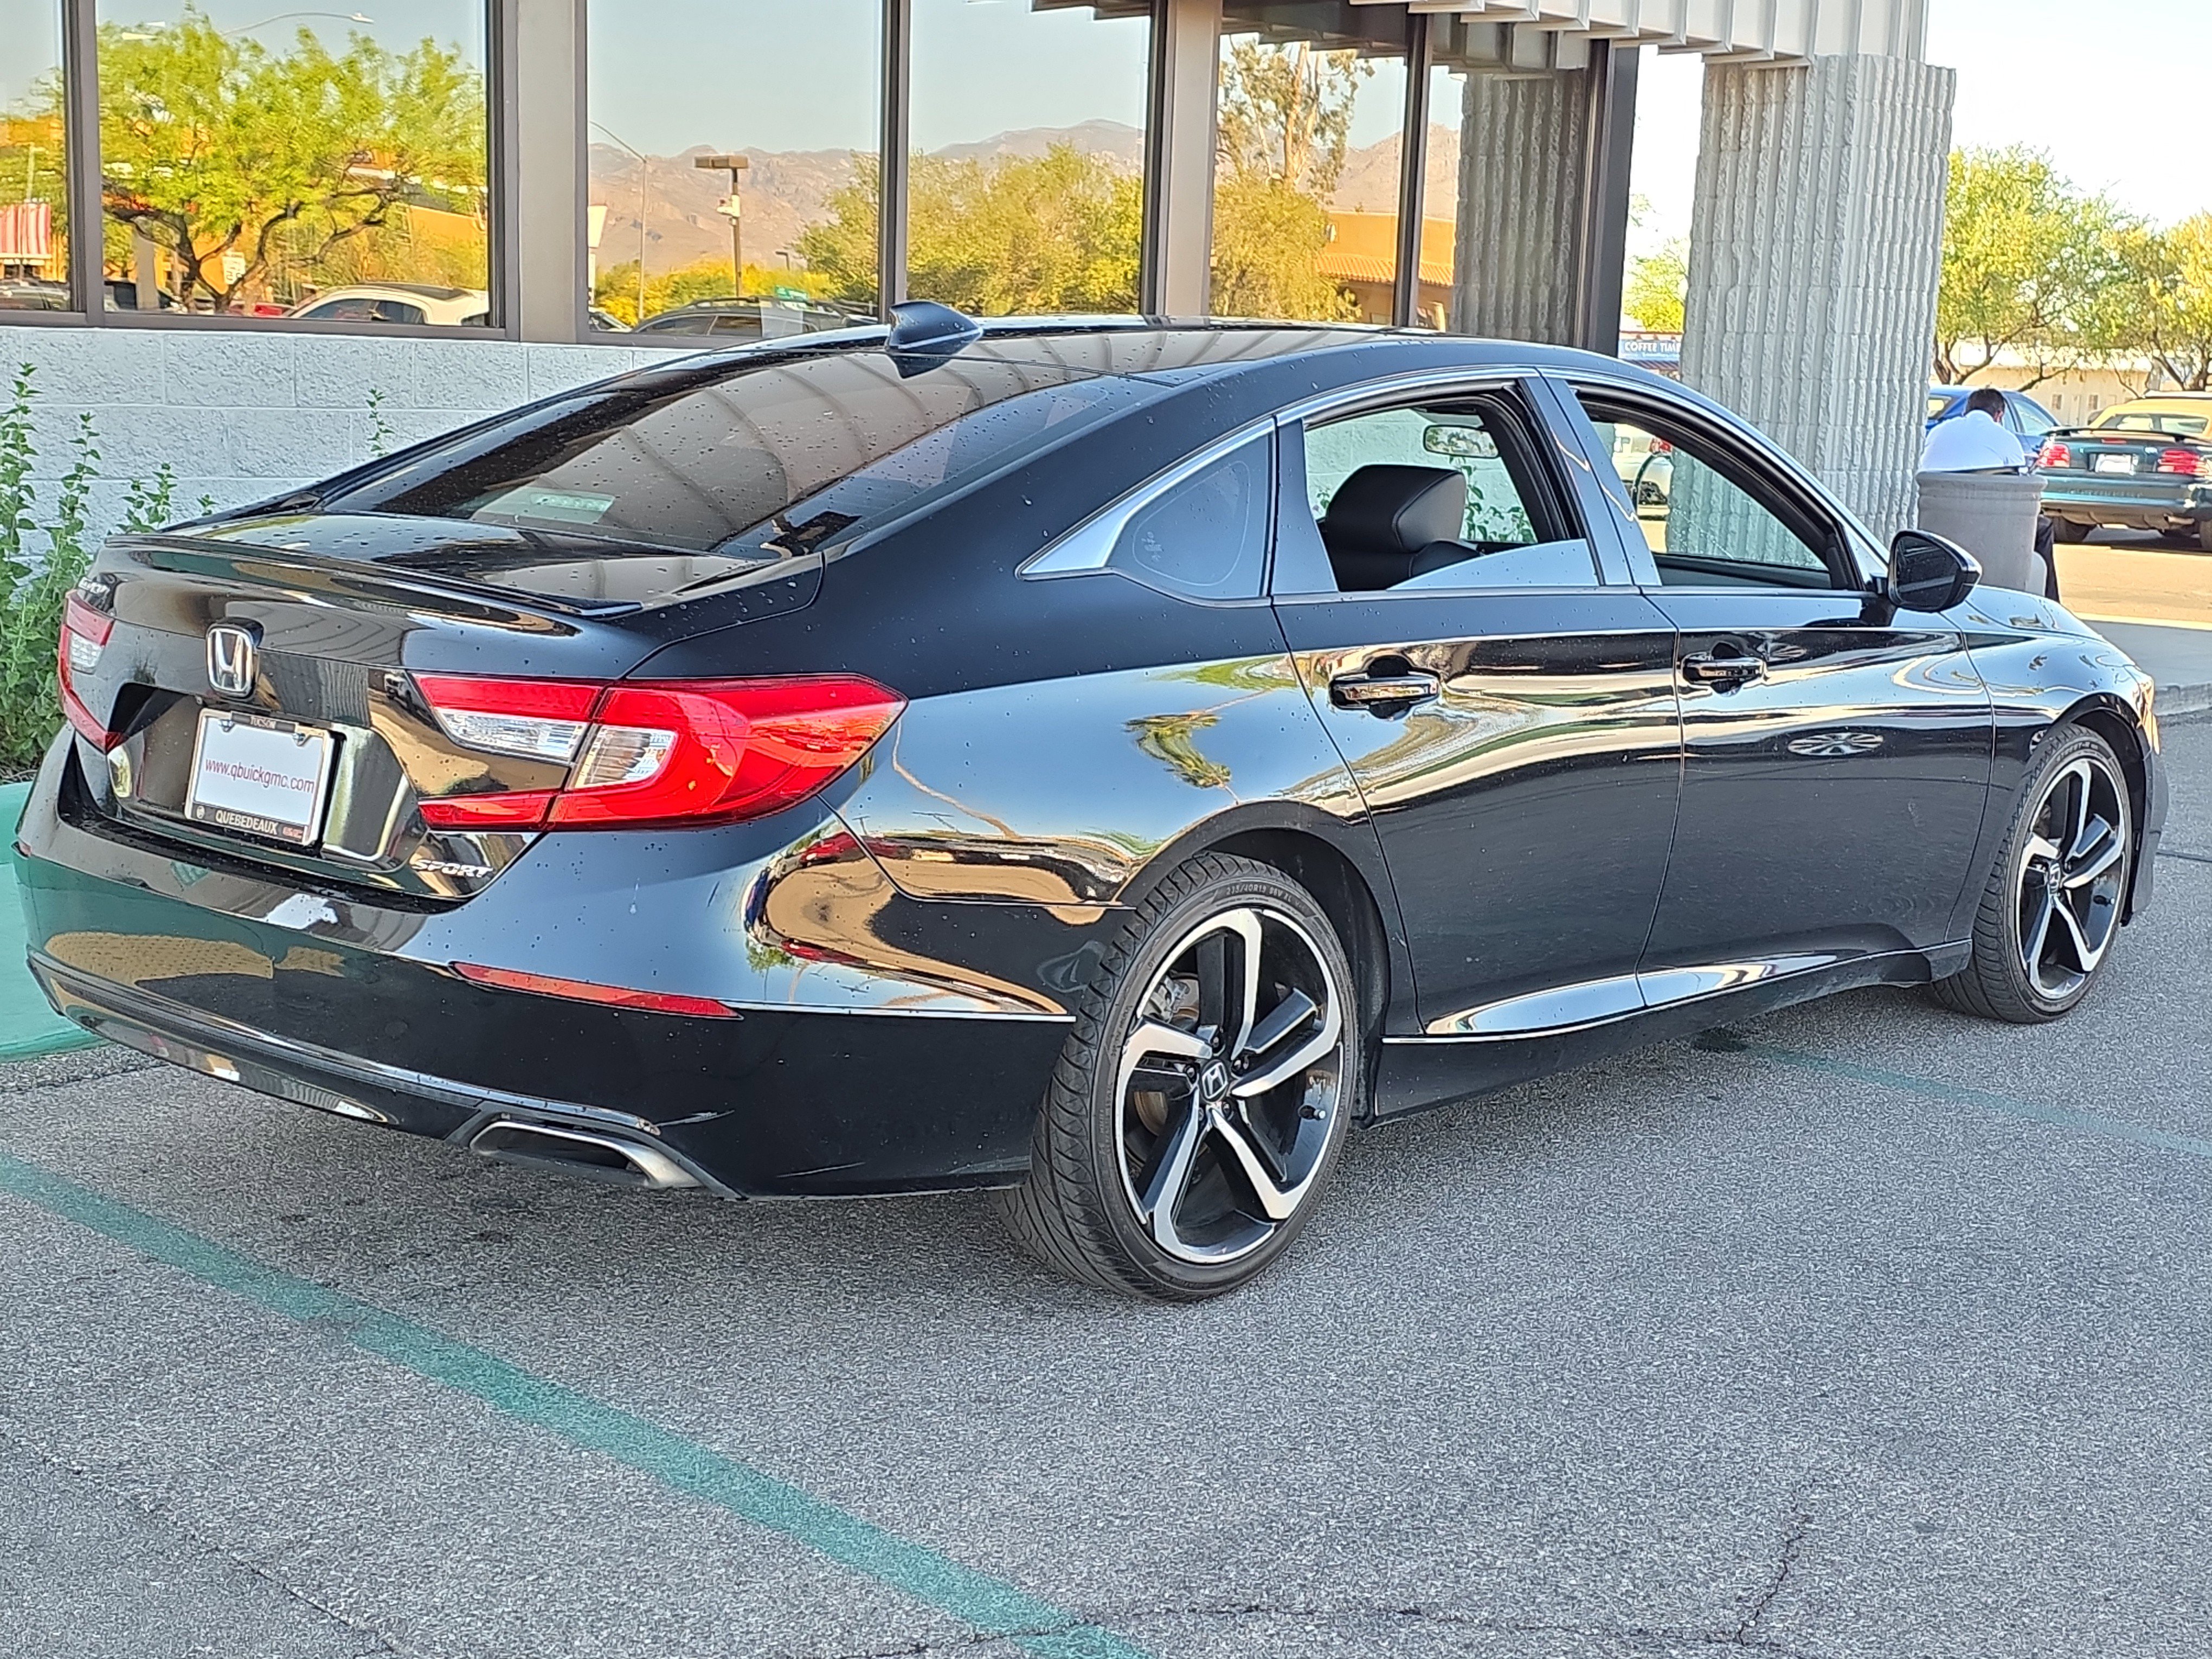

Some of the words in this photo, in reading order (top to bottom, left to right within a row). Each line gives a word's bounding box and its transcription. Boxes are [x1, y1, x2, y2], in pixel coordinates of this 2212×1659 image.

[1624, 341, 1657, 352] COFFEE
[250, 716, 276, 729] TUCSON
[205, 758, 314, 793] www.qbuickgmc.com
[215, 809, 279, 835] QUEBEDEAUX
[410, 859, 493, 878] SPORT
